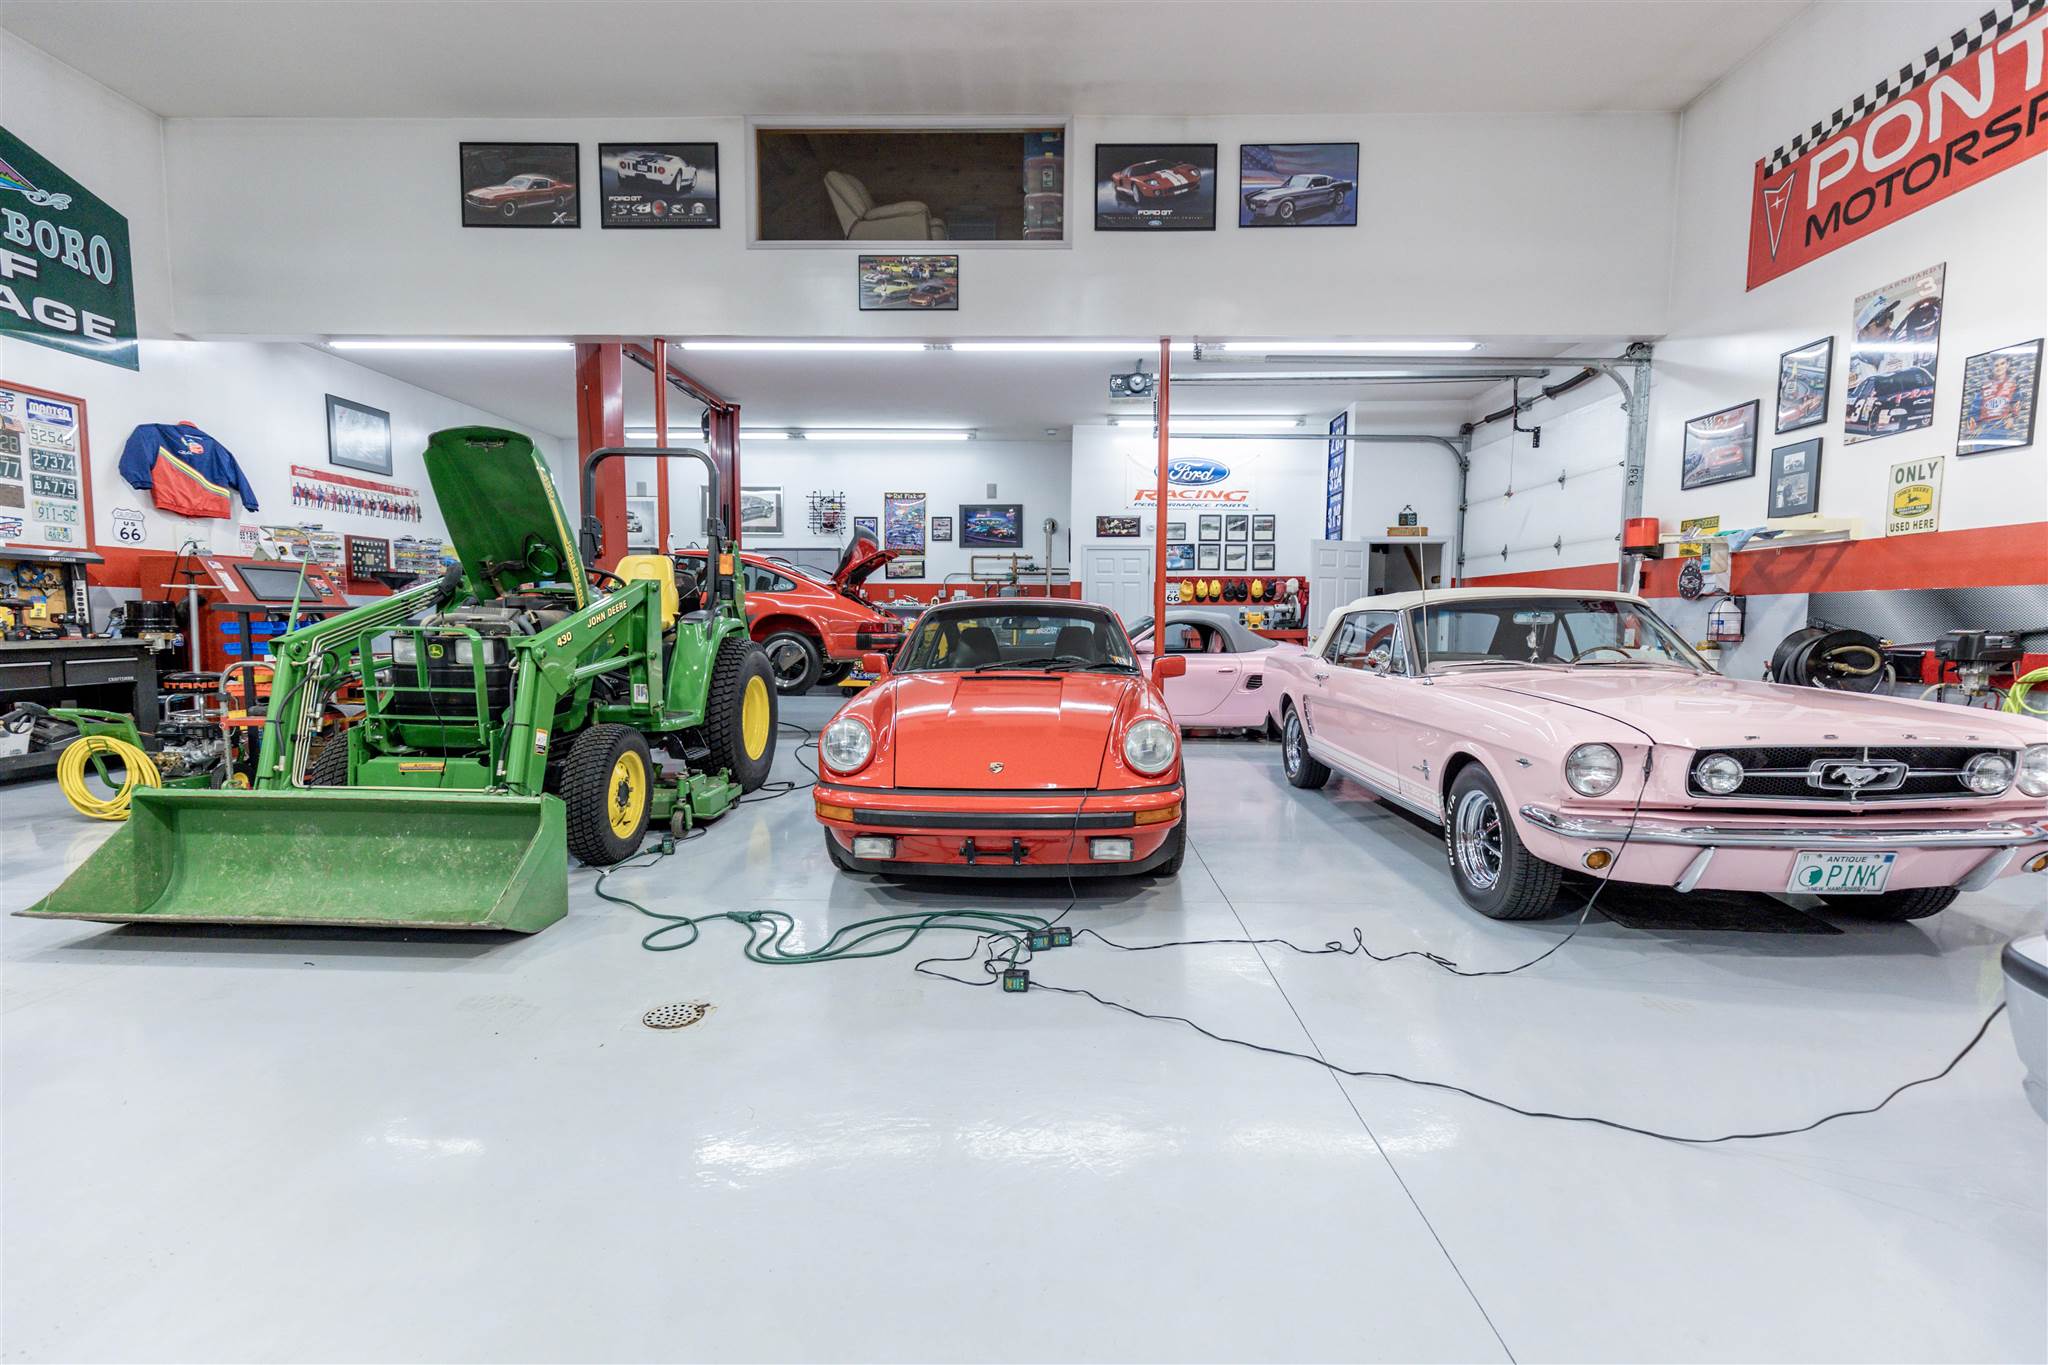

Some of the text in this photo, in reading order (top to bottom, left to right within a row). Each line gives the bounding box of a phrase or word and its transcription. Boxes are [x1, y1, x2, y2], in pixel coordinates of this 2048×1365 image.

[1, 207, 113, 285] BORO
[33, 453, 74, 471] 27374
[1169, 462, 1215, 482] Ford
[1895, 461, 1938, 485] ONLY
[34, 480, 75, 495] BA779
[38, 506, 76, 522] 911-SC
[1890, 518, 1934, 532] USED HERE
[120, 527, 141, 541] 66
[1166, 594, 1180, 602] 66
[587, 599, 628, 629] JOHN DEERE
[556, 631, 573, 648] 430
[1825, 864, 1884, 887] PINK
